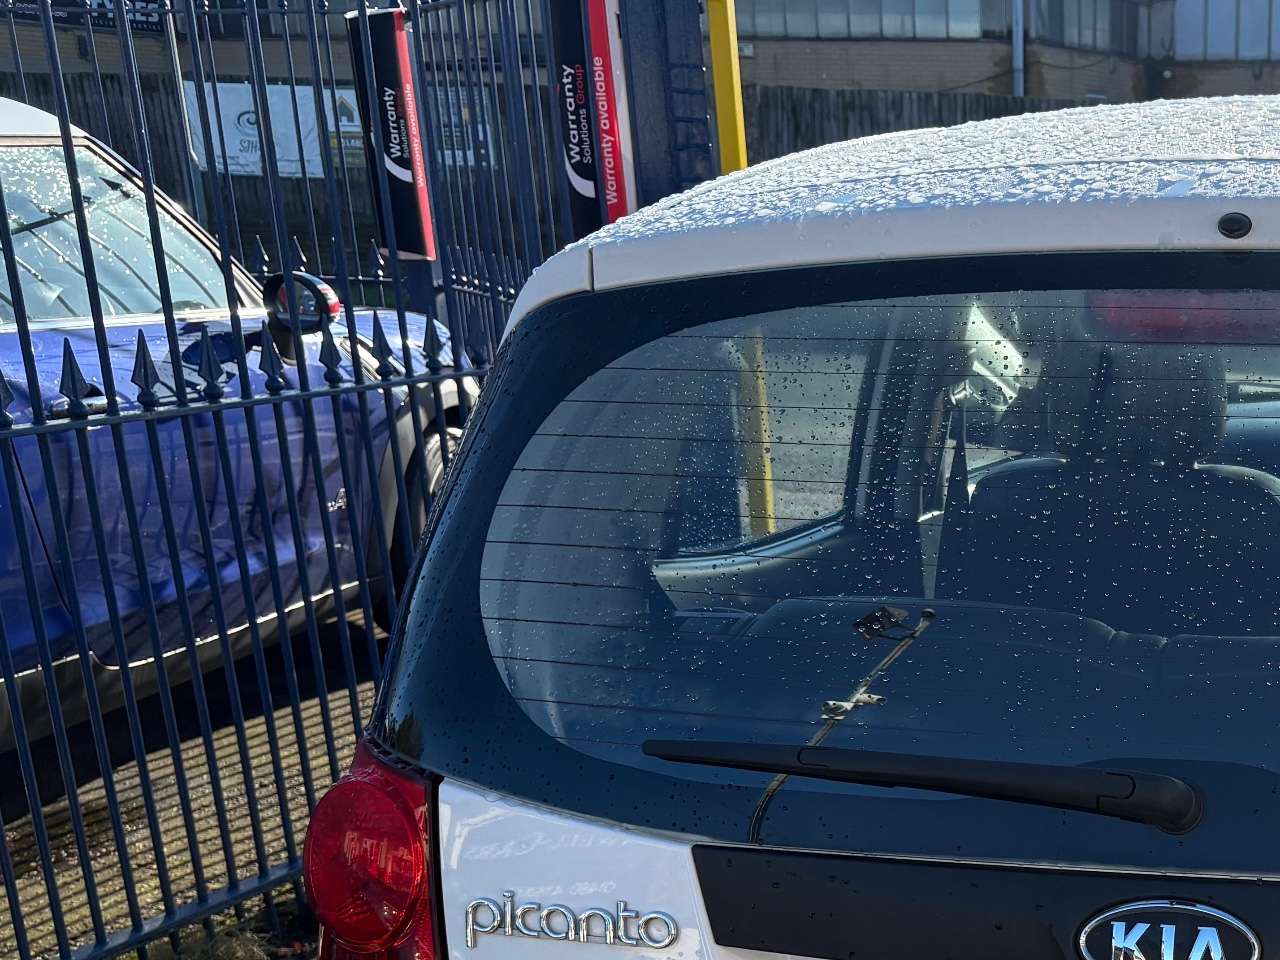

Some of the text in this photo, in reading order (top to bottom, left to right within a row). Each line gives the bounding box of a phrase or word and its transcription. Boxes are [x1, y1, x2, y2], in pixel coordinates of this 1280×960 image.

[384, 87, 402, 158] Warranty
[399, 119, 410, 159] Solutions
[404, 83, 425, 187] Warranty available
[562, 65, 581, 164] Warranty
[575, 64, 592, 164] Solutions Group
[593, 57, 618, 205] Warranty available
[465, 890, 678, 950] picanto
